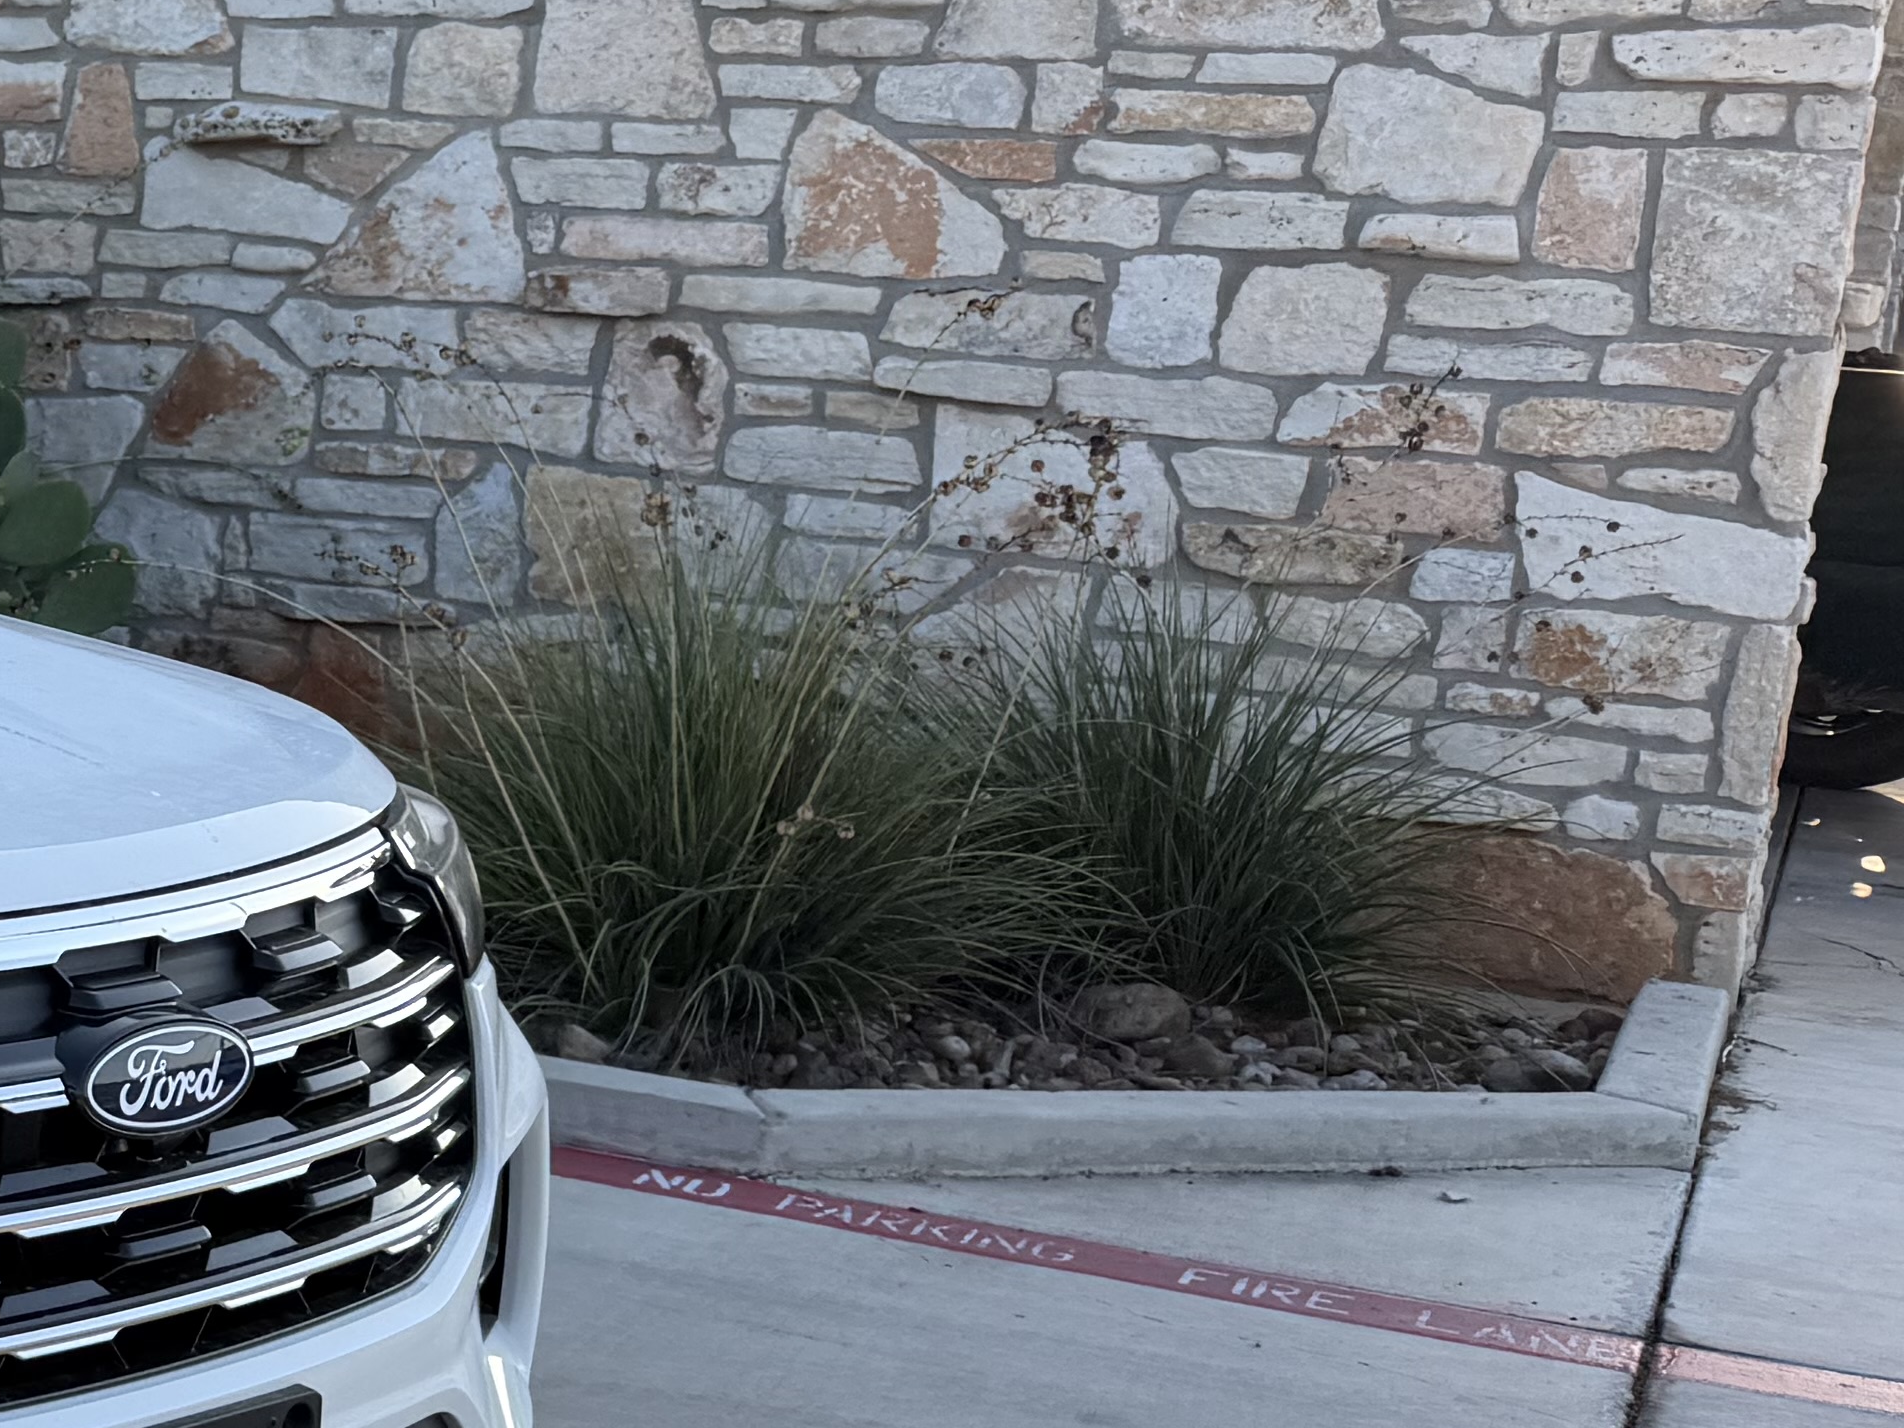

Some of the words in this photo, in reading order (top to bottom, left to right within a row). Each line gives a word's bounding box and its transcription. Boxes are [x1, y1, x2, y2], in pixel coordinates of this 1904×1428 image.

[119, 1040, 223, 1116] Ford
[775, 1193, 1075, 1262] PARKING
[1177, 1268, 1356, 1316] FIRE
[1415, 1309, 1617, 1364] LANE
